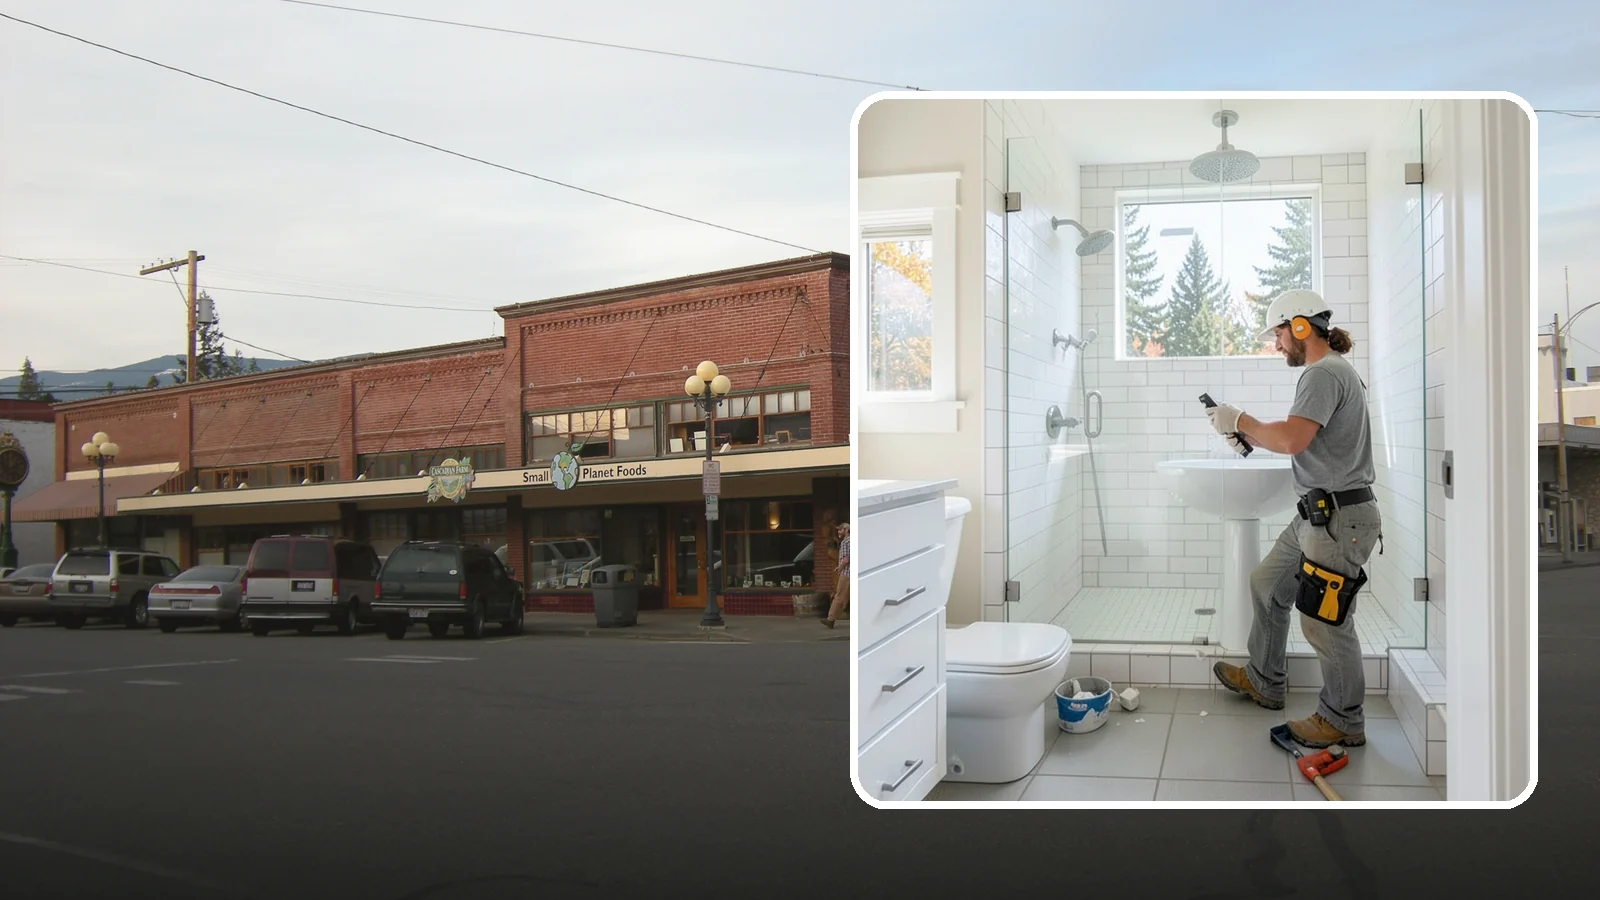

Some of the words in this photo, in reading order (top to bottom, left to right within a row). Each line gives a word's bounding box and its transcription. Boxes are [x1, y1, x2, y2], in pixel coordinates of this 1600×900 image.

[523, 471, 549, 483] Small
[582, 468, 614, 479] Planet
[617, 464, 647, 477] Foods
